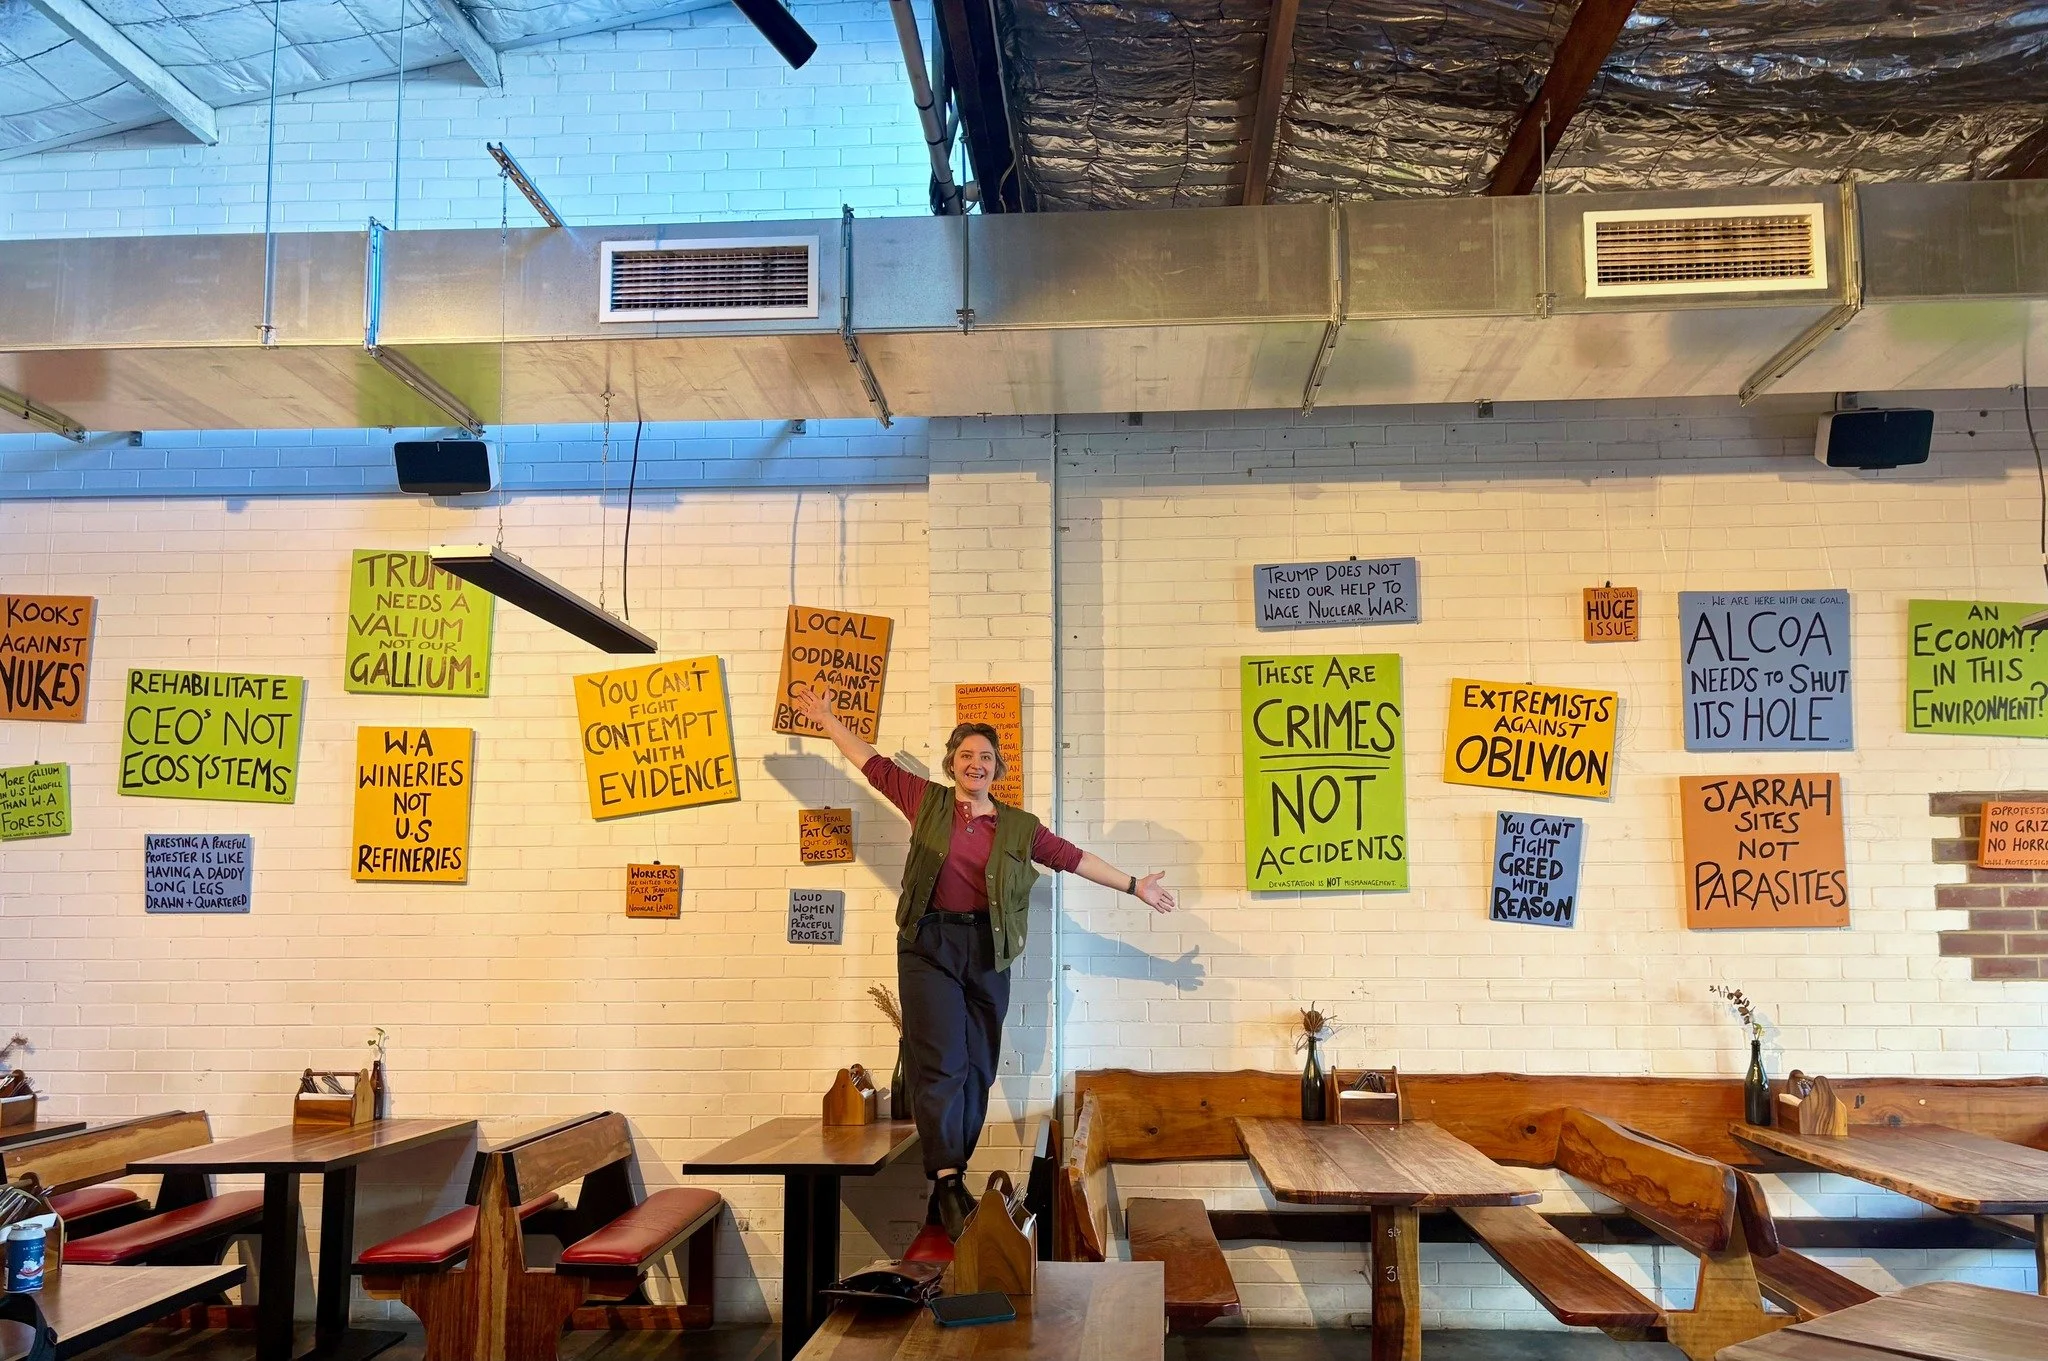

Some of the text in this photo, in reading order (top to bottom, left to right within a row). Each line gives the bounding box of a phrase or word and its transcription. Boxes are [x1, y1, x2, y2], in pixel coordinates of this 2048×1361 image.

[358, 553, 464, 591] TRUM
[1261, 563, 1401, 584] TRUMP DOES NOT
[1268, 580, 1401, 599] NEED OUR HELP TO
[1591, 589, 1610, 600] TINY
[1712, 596, 1726, 606] WE
[1730, 596, 1749, 605] ARE
[1754, 596, 1776, 605] HERE
[1779, 596, 1798, 605] WITH
[1801, 596, 1816, 605] ONE
[7, 597, 84, 628] KOOKS
[376, 590, 470, 613] NEEDS A
[1264, 603, 1300, 621] WAGE
[1309, 600, 1363, 619] NUCLEAR
[1587, 600, 1635, 620] HUGE
[1968, 605, 1999, 620] AN
[350, 612, 464, 642] VALIUM
[794, 609, 876, 640] LOCAL
[0, 632, 87, 657] AGAINST
[379, 639, 457, 654] NOT OUR
[1687, 612, 1832, 664] ALCOA
[1914, 623, 2043, 656] ECONOMY?
[791, 646, 883, 677] ODDBALLS
[1248, 656, 1376, 690] THESE ARE
[1933, 657, 2023, 687] IN THIS
[0, 655, 84, 713] NUKES
[131, 671, 288, 700] REHABILITATE
[588, 661, 709, 708] YOU CAN'T
[813, 669, 880, 692] AGAINST
[958, 685, 1017, 695] @LAURADAVISCOMIC
[1691, 664, 1849, 694] NEEDS TO SHUT
[787, 680, 875, 713] GOBAL
[959, 702, 1005, 710] PROTEST SIGNS
[1463, 685, 1612, 722] EXTREMISTS
[1913, 681, 2048, 728] ENVIRONMENT?
[629, 699, 678, 719] FIGHT
[991, 711, 1006, 719] YOU
[1010, 711, 1016, 719] IS
[1694, 696, 1833, 741] ITS HOLE
[224, 708, 292, 749] NOT
[585, 710, 718, 755] CONTEMPT
[1253, 699, 1401, 752] CRIMES
[1493, 715, 1586, 739] AGAINST
[384, 728, 433, 757] W.A
[633, 744, 685, 765] WITH
[1455, 734, 1609, 786] OBLIVION
[28, 767, 59, 784] GALLIUM
[122, 751, 292, 795] ECOSYSTEMS
[359, 759, 464, 789] WINERIES
[599, 754, 732, 806] EVIDENCE
[29, 781, 62, 795] LANDFILL
[1701, 778, 1832, 816] JARRAH
[0, 798, 27, 810] THAN
[393, 791, 432, 817] NOT
[1271, 773, 1377, 837] NOT
[803, 812, 843, 823] KEEP FERAL
[1500, 813, 1575, 838] YOU CAN'T
[1734, 811, 1800, 833] SITES
[1990, 821, 2008, 833] NO
[395, 817, 432, 843] U.S
[800, 823, 851, 839] FAT CATS
[146, 835, 246, 850] ARRESTING A PEACEFUL
[803, 839, 848, 847] OUT OF WA
[1512, 835, 1560, 857] FIGHT
[1738, 838, 1800, 861] NOT
[1988, 838, 2006, 852] NO
[145, 851, 244, 864] PROTESTER IS LIKE
[358, 844, 462, 873] REFINERIES
[1499, 852, 1563, 880] GREED
[146, 866, 245, 881] HAVING A DADDY
[631, 867, 677, 879] WORKERS
[1268, 880, 1315, 889] DEVASTATION
[1326, 877, 1342, 888] NOT
[147, 880, 224, 895] LONG LEGS
[631, 886, 649, 894] FAIR
[793, 892, 822, 902] LOUD
[1512, 877, 1549, 897] WITH
[1695, 861, 1847, 911] PARASITES
[146, 894, 247, 909] DRAWN + QUARTERED
[644, 894, 665, 902] NOT
[656, 904, 673, 912] LAND
[793, 904, 835, 914] WOMEN
[1493, 886, 1573, 921] REASON
[791, 919, 832, 929] PEACEFUL
[800, 913, 815, 921] FOR
